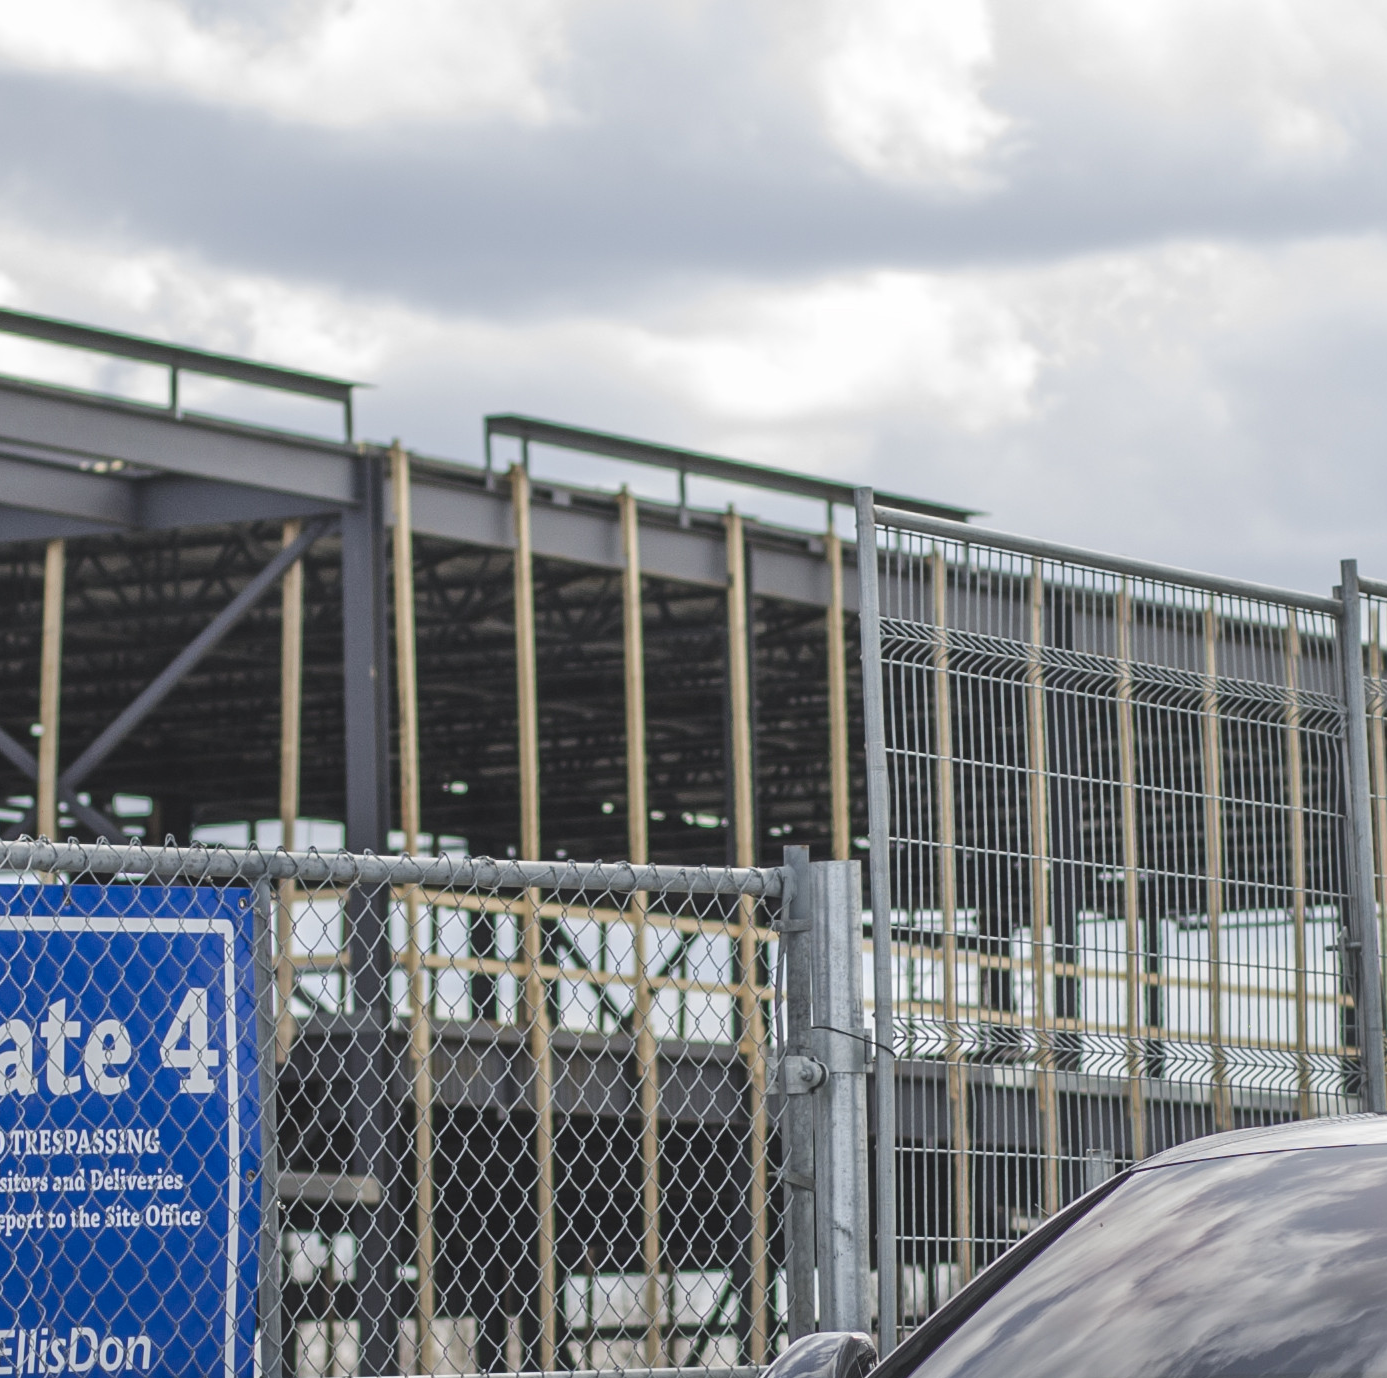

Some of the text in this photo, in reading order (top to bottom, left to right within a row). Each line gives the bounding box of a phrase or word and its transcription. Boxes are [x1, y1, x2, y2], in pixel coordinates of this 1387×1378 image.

[159, 987, 220, 1094] 4
[10, 1128, 161, 1156] TRESPASSING
[52, 1168, 86, 1192] and
[90, 1167, 183, 1191] Deliveries
[49, 1210, 66, 1229] to
[70, 1205, 101, 1228] the
[105, 1204, 141, 1228] Site
[145, 1203, 202, 1227] Office
